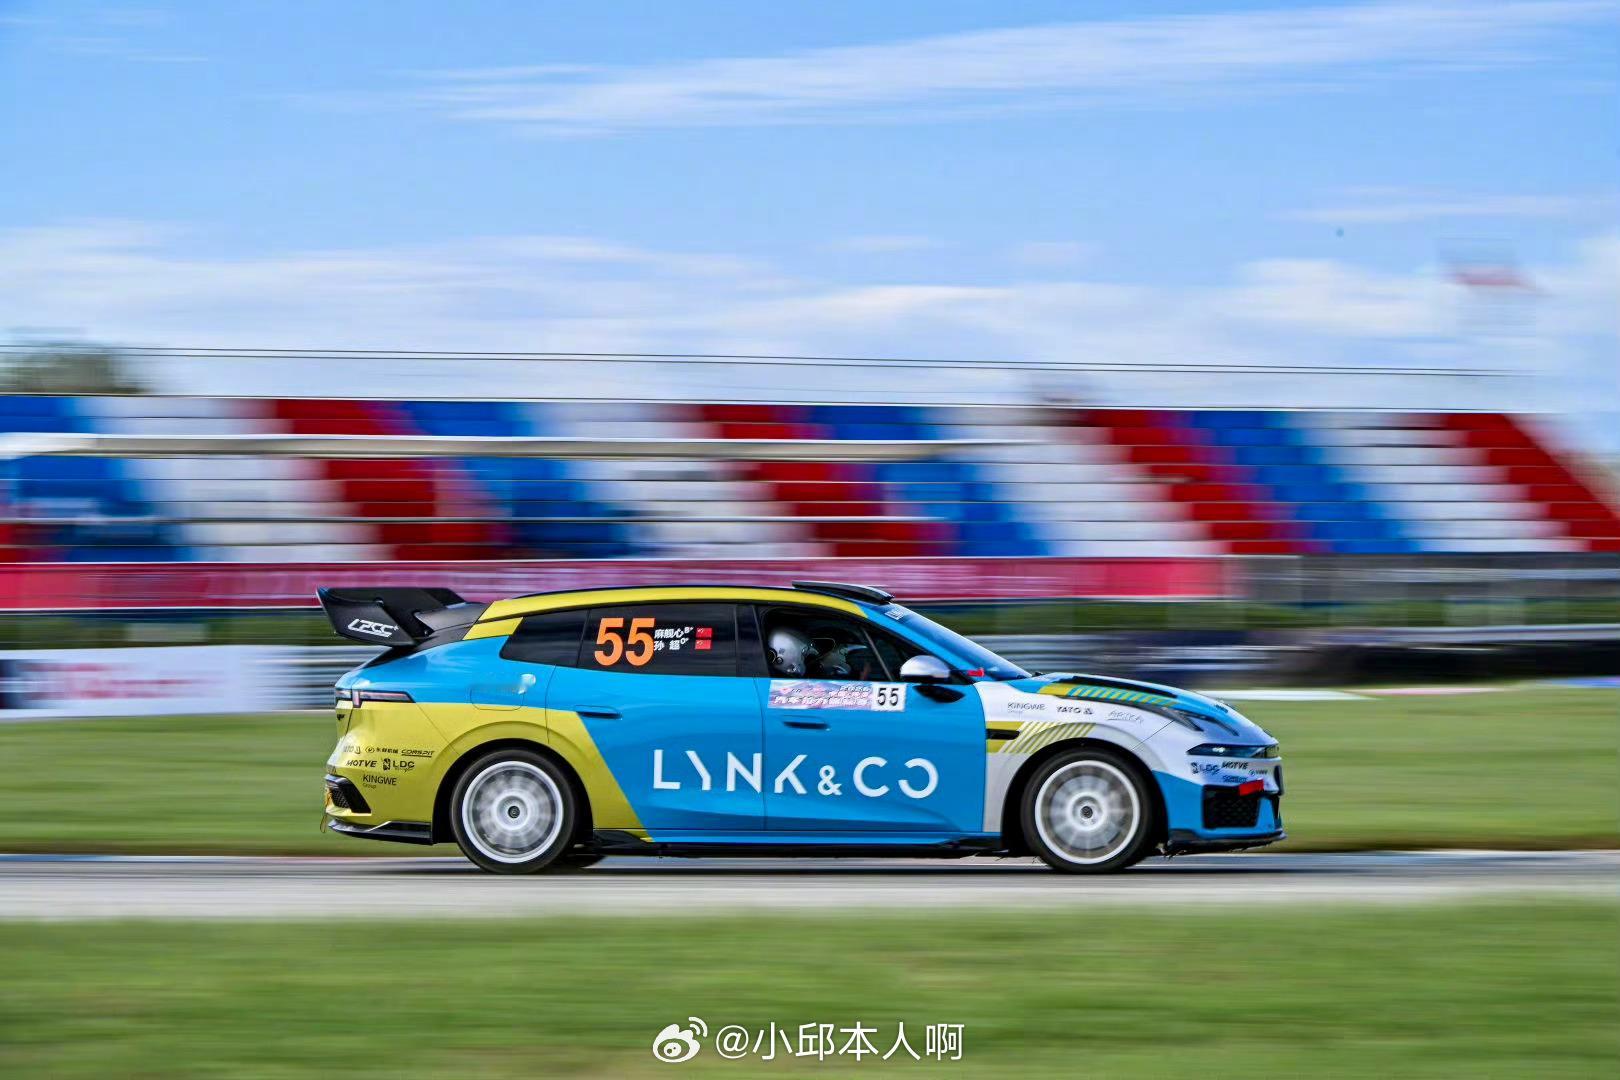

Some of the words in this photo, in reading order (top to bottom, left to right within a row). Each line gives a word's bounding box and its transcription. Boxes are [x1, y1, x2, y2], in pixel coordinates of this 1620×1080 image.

[594, 617, 656, 667] 55
[877, 687, 899, 706] 55
[1007, 702, 1045, 711] KINGWE
[362, 774, 397, 786] KINGWE
